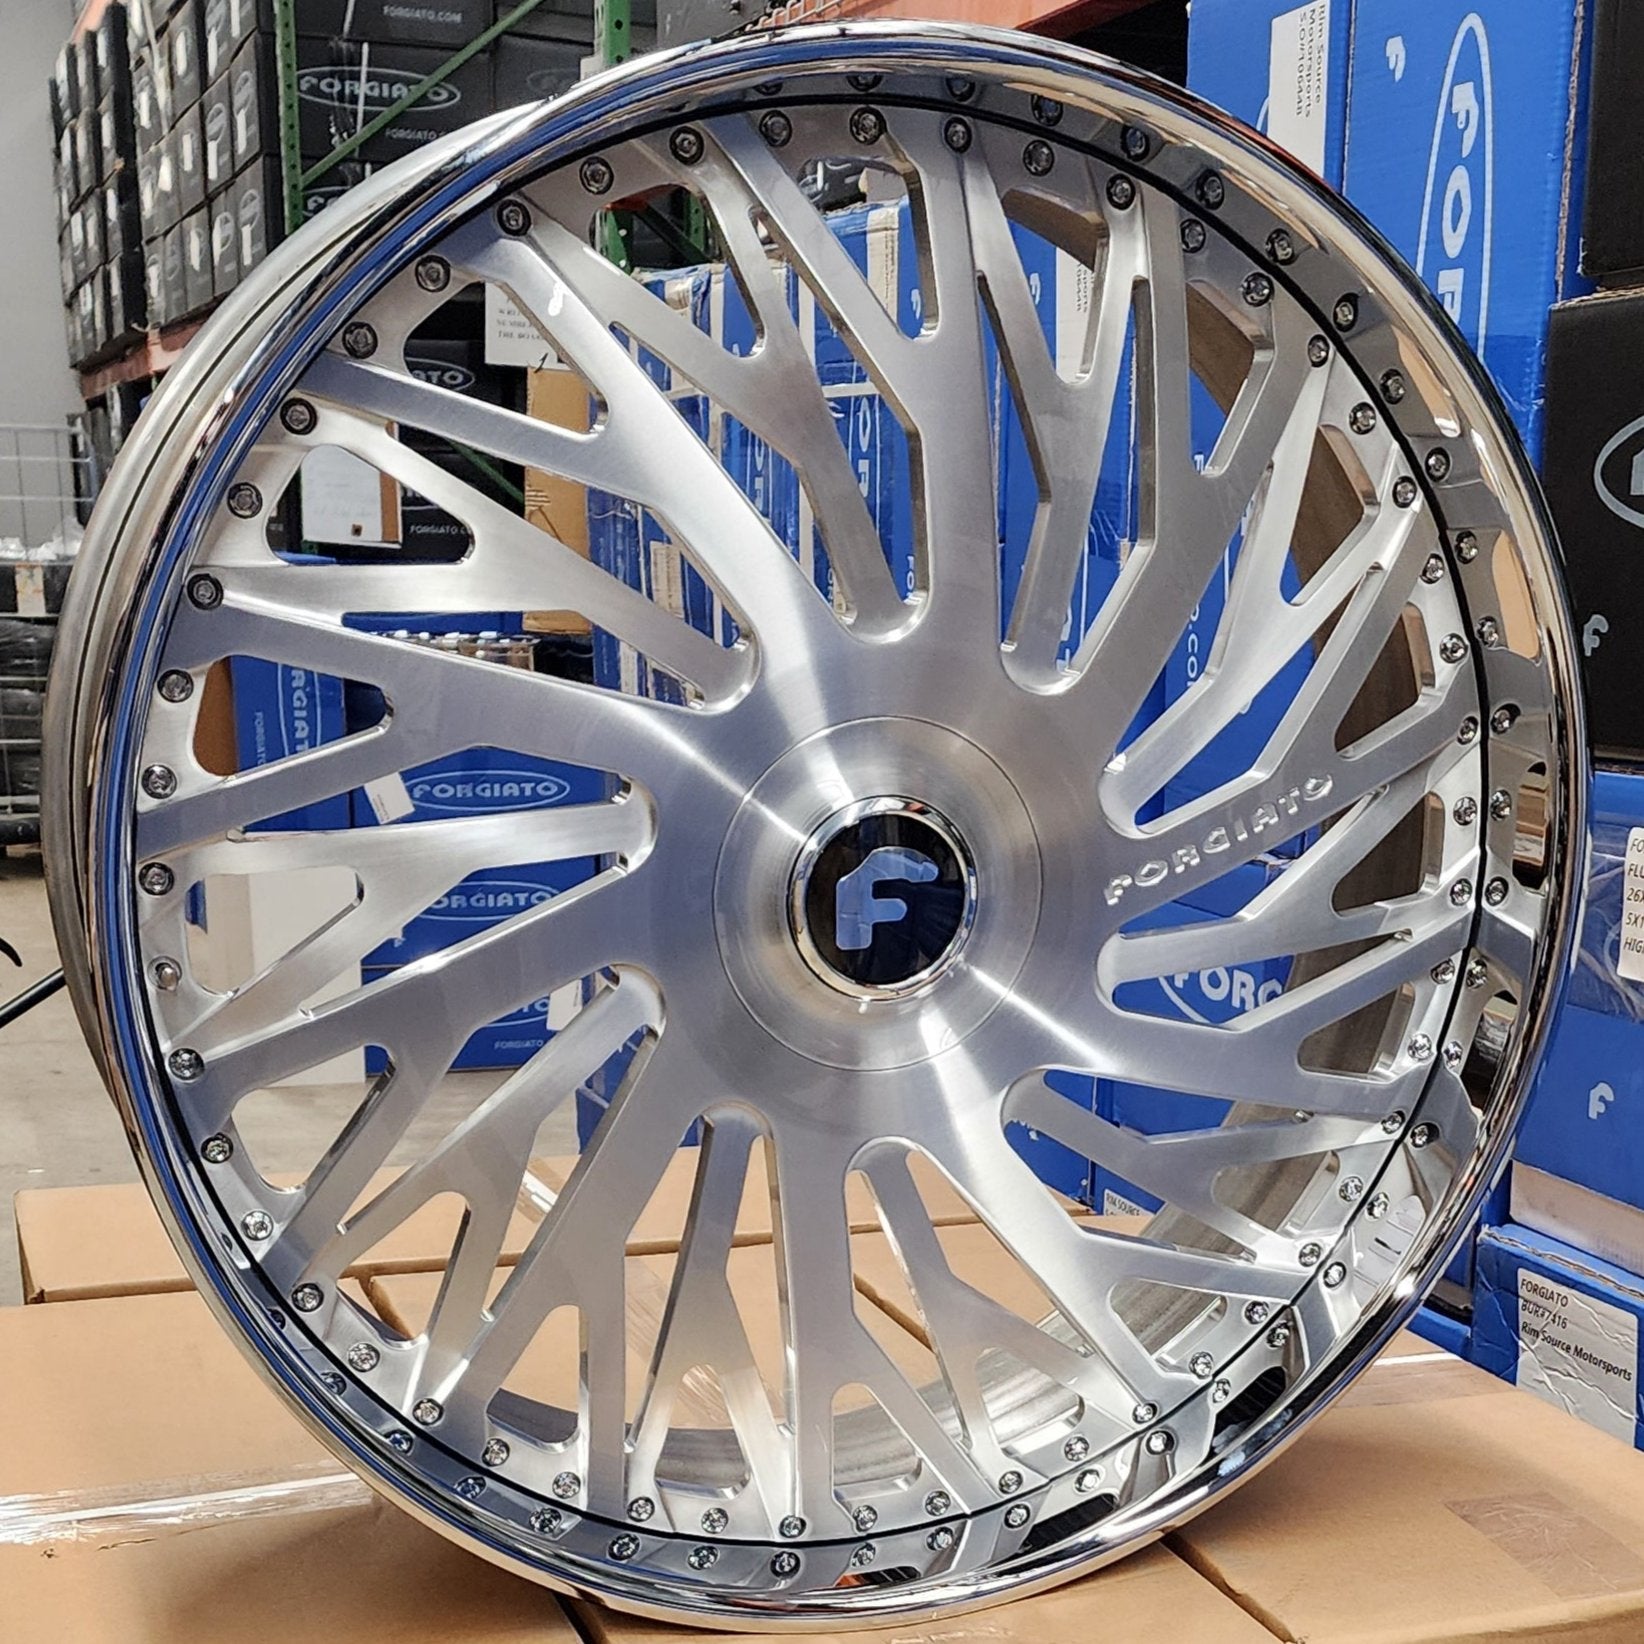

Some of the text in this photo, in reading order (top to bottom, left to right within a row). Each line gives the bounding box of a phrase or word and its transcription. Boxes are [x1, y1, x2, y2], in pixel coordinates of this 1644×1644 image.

[300, 77, 449, 101] FORGIAO
[412, 782, 558, 799] FORGIATO
[1103, 773, 1334, 906] FORGIATO
[1520, 1278, 1569, 1308] FORGIATO
[1521, 1321, 1632, 1382] Rim Source Motorsports
